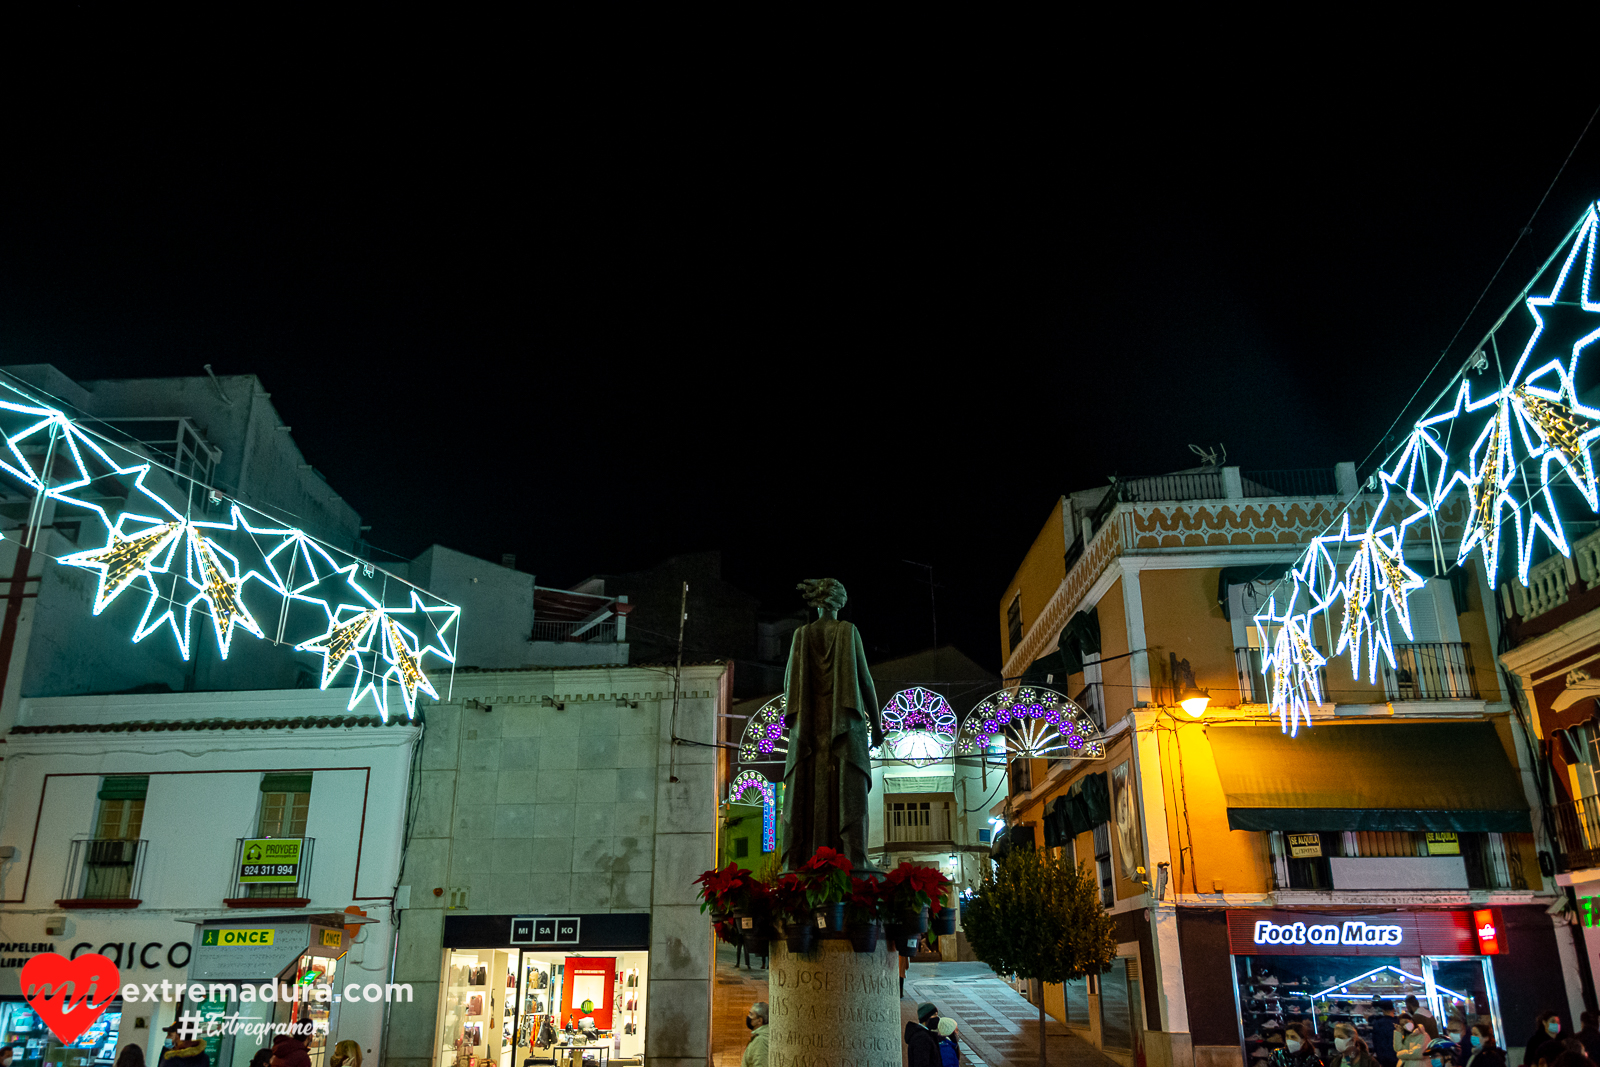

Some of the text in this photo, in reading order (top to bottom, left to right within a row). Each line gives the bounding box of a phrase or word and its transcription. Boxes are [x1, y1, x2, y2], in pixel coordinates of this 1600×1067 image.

[1290, 835, 1319, 846] SE ALQUILA
[266, 844, 298, 854] PROYGEB
[244, 865, 293, 875] 924 311 994
[224, 931, 269, 943] ONCE
[1256, 922, 1399, 943] Foot on Mars
[325, 932, 340, 945] ONCE
